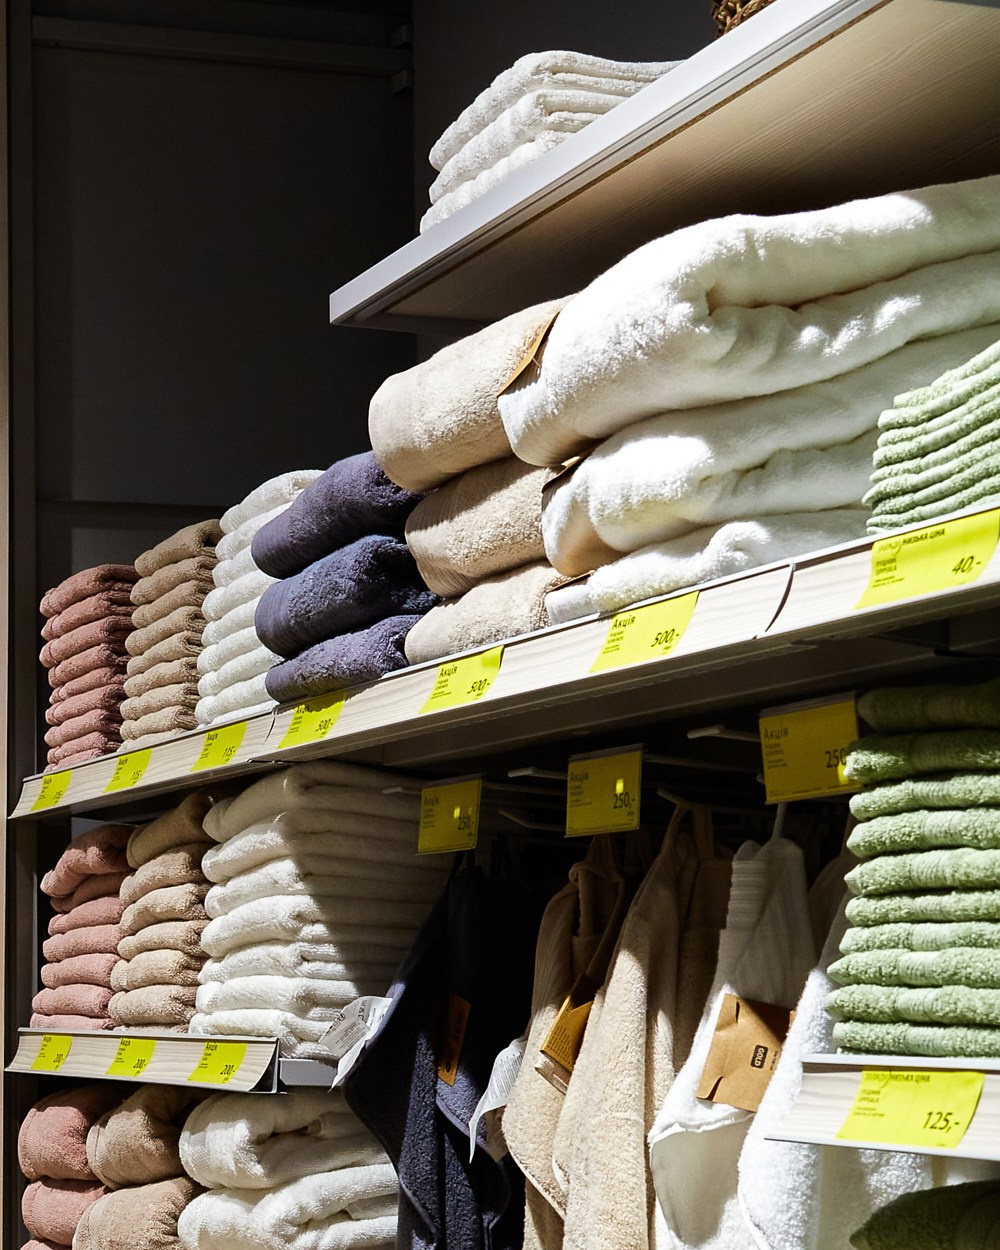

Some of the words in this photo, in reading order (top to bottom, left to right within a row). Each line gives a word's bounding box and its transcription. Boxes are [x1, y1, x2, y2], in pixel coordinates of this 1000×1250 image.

[951, 555, 982, 575] 40,-
[612, 615, 636, 629] Акція
[650, 628, 680, 648] 500,-
[439, 665, 458, 678] Акція
[466, 678, 491, 695] 500,-
[612, 791, 637, 811] 250,-
[457, 815, 475, 833] 250,-
[754, 1047, 765, 1066] GOLD
[922, 1111, 960, 1134] 125,-
